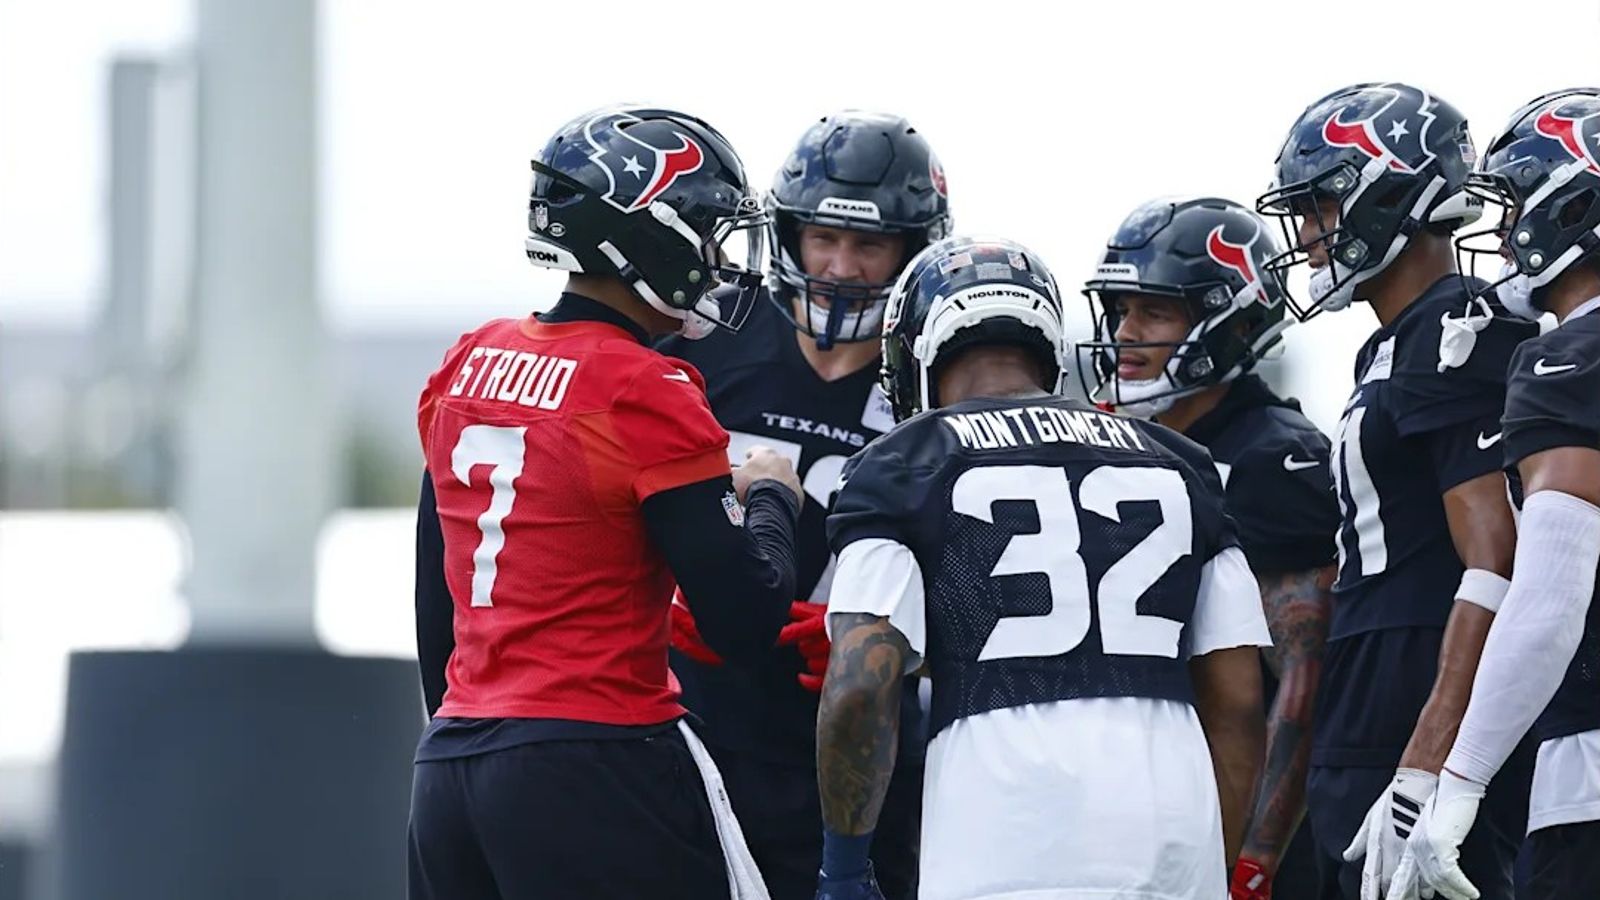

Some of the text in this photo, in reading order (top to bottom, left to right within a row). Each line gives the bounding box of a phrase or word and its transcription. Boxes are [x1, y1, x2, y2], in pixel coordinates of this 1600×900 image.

[826, 203, 874, 213] TEXANS
[968, 290, 1030, 300] HOUSTON
[450, 346, 578, 411] STROUD
[761, 412, 866, 448] TEXANS
[944, 406, 1146, 451] MONTGOMERY
[451, 424, 529, 608] 7
[952, 465, 1193, 662] 32
